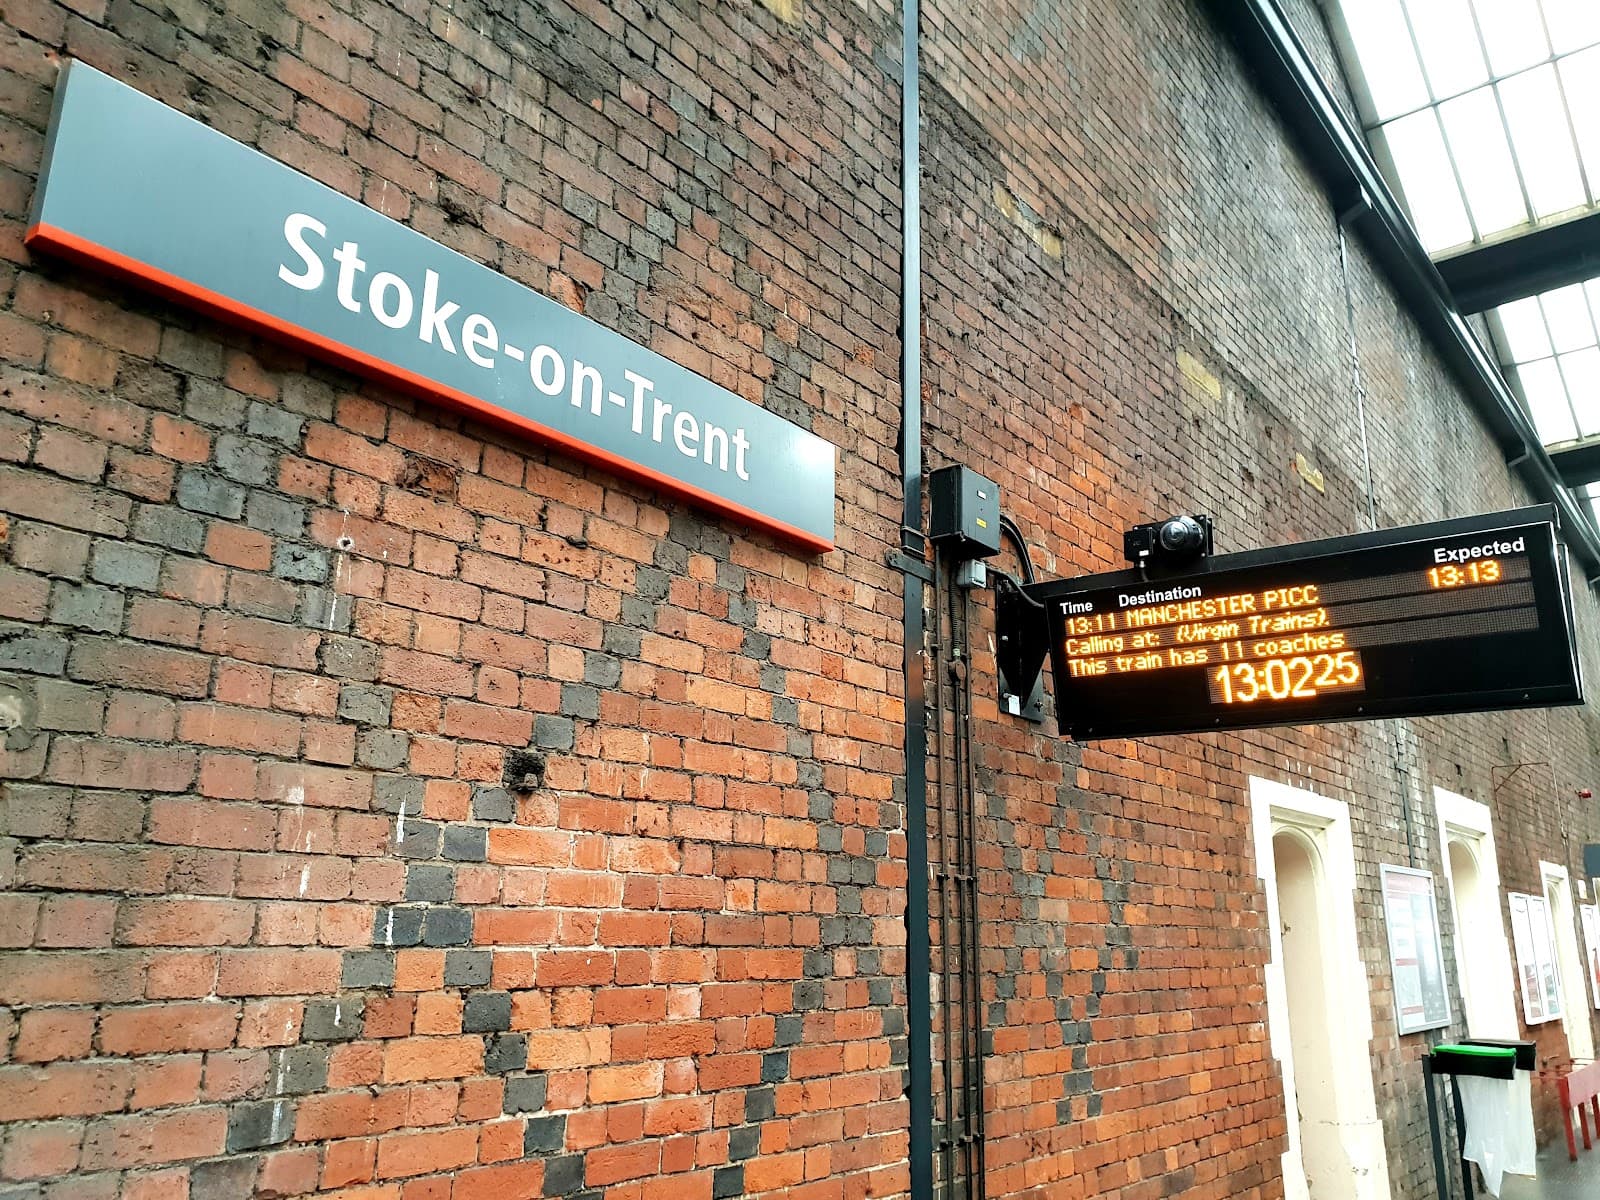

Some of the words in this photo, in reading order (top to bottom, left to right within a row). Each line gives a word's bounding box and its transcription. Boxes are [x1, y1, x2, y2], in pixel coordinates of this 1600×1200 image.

[277, 212, 751, 482] Stoke-on-Trent
[1433, 537, 1525, 563] Expected
[1428, 559, 1500, 588] 13:13
[1060, 601, 1093, 615] Time
[1067, 612, 1116, 635] 13:11
[1126, 593, 1257, 628] MANCHESTER
[1263, 584, 1320, 610] PICC
[1118, 586, 1202, 608] Destination
[1065, 636, 1124, 657] Calling
[1132, 631, 1161, 648] at:
[1176, 620, 1240, 643] (Virgin
[1068, 658, 1108, 677] This
[1115, 651, 1163, 672] train
[1169, 648, 1209, 666] has
[1221, 640, 1244, 661] 11
[1253, 632, 1346, 658] coaches
